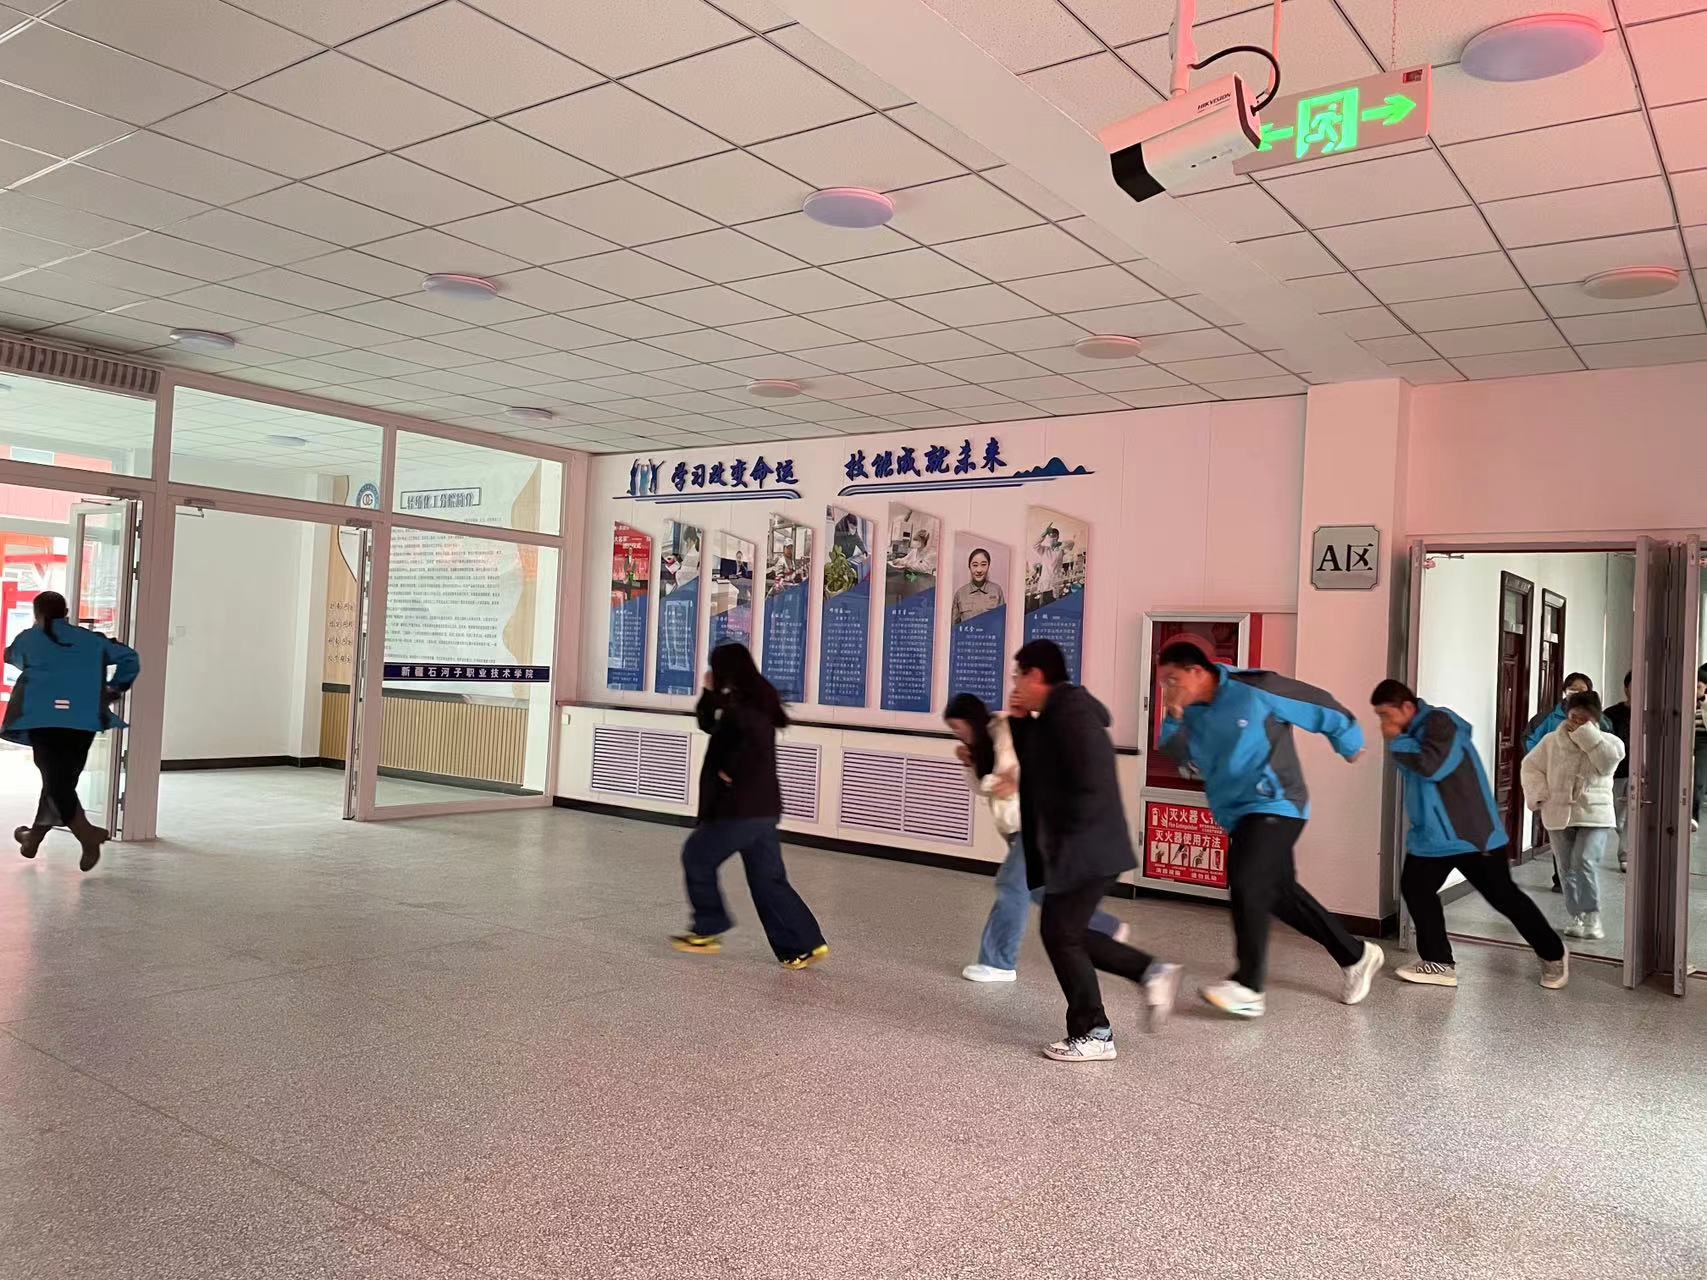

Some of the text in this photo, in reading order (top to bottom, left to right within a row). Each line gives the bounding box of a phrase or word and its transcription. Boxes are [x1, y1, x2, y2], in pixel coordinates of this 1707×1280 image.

[846, 436, 1008, 480] 技能成就未来
[671, 455, 799, 492] 学习改变命运
[1316, 543, 1374, 572] A区
[401, 666, 534, 679] 新疆石河子职业技术学院
[1169, 808, 1199, 824] 灭火器
[1155, 830, 1221, 848] 灭火器使用方法
